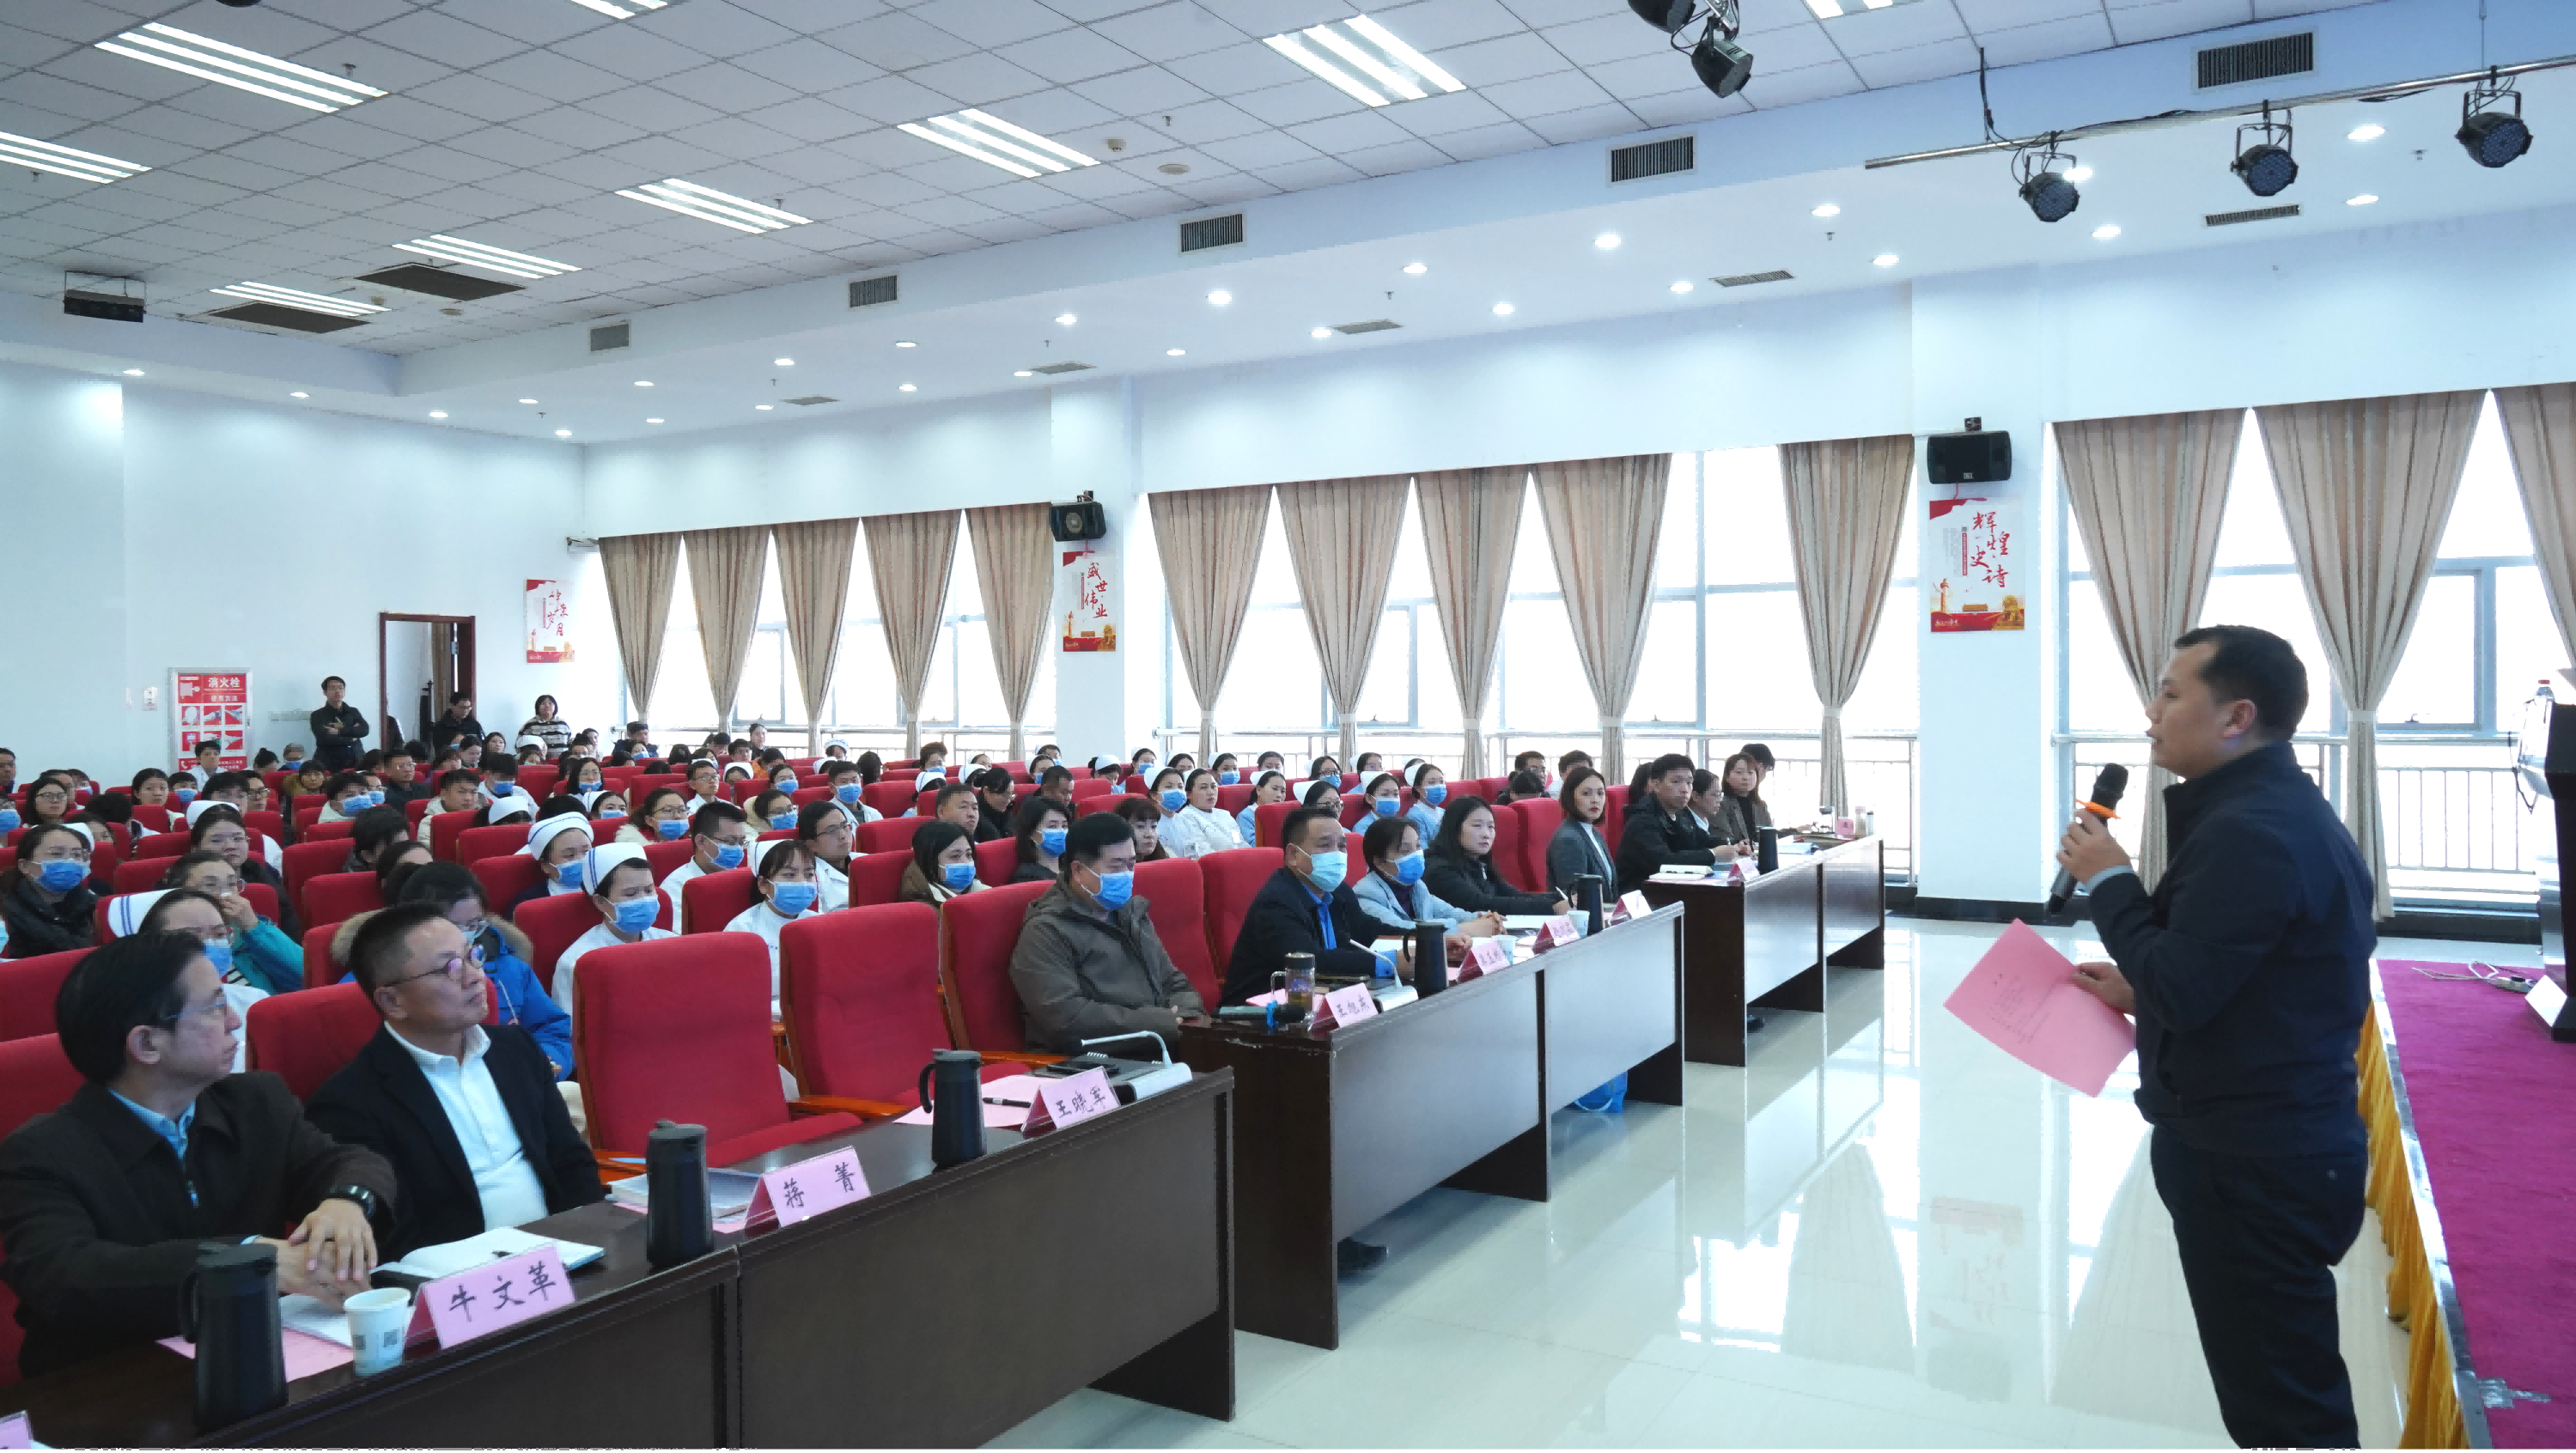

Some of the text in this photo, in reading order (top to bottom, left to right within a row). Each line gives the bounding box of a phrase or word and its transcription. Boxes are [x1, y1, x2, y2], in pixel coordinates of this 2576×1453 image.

[1085, 562, 1108, 619] 盛世伟业
[208, 677, 241, 688] 消火栓
[448, 1259, 557, 1322] 牛文革
